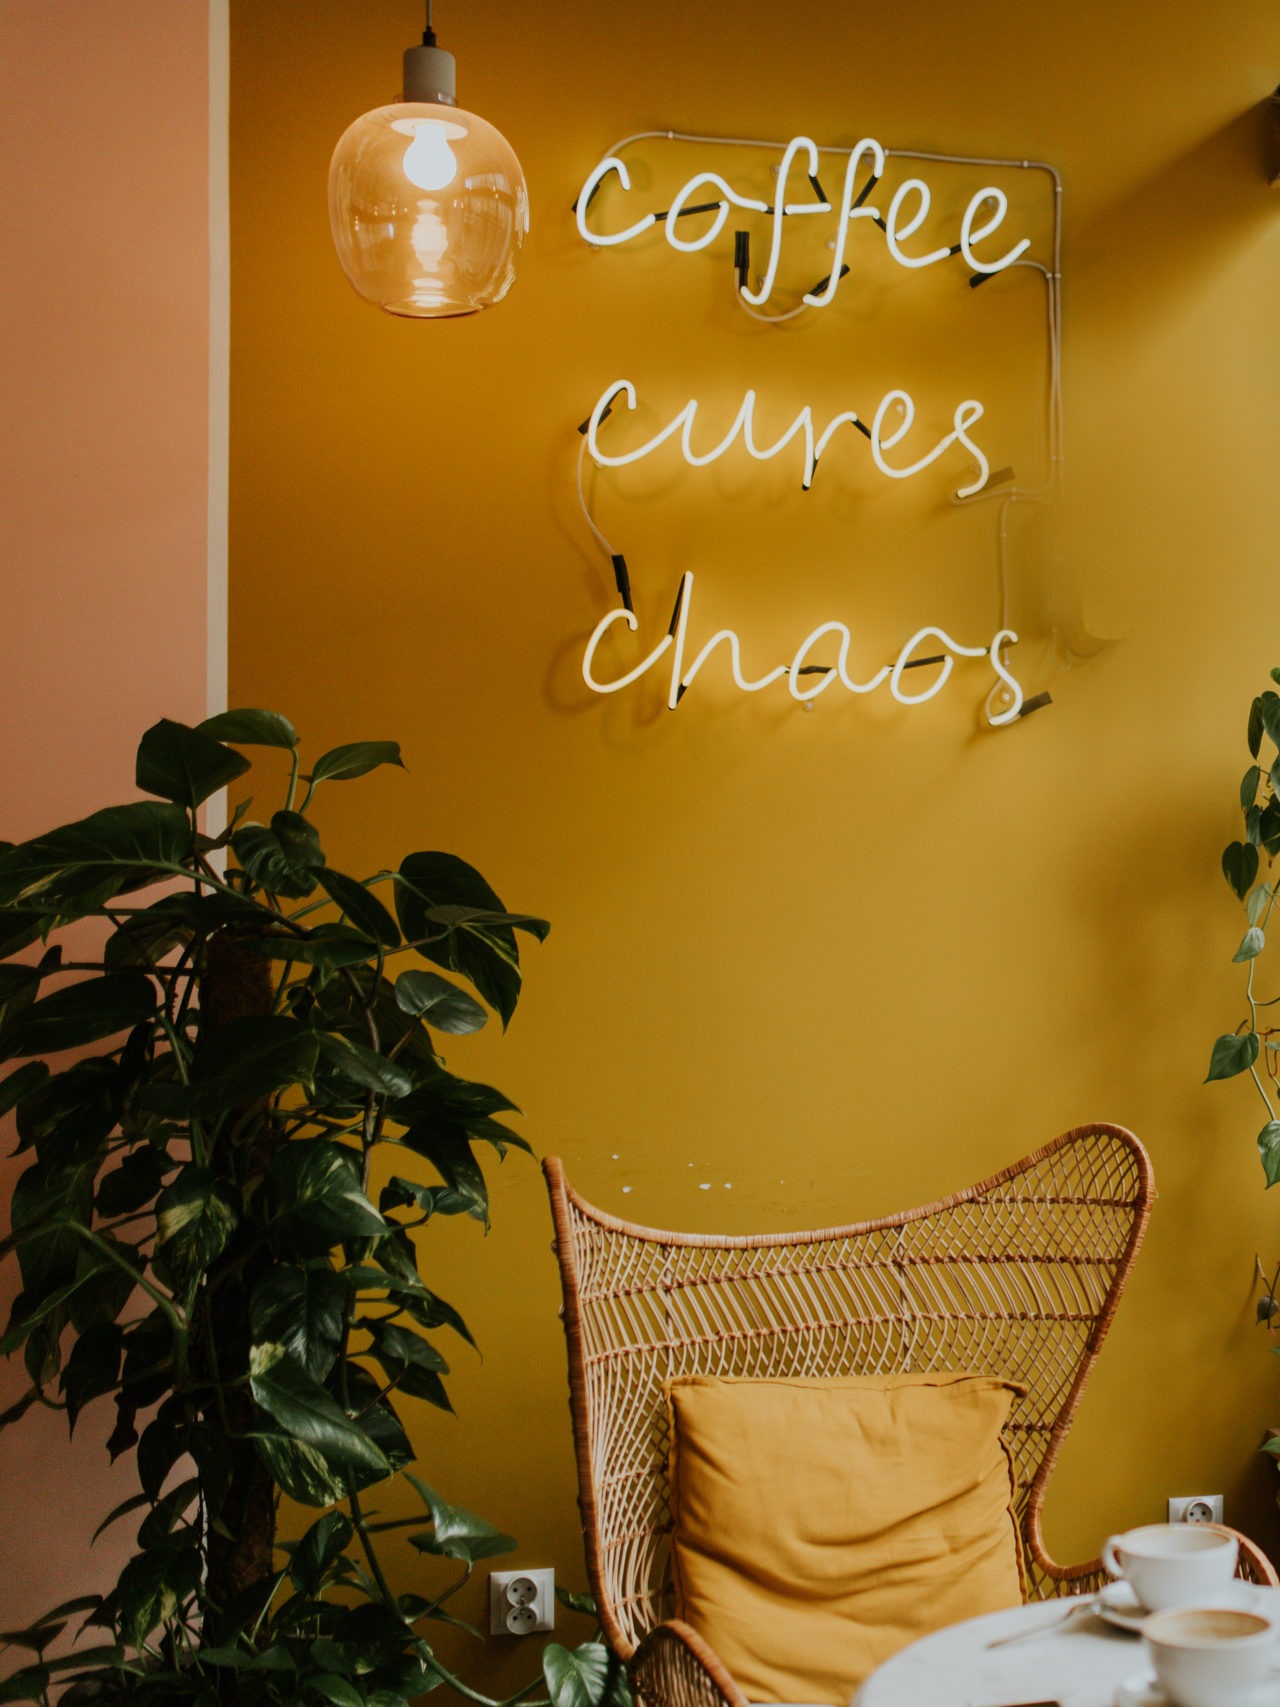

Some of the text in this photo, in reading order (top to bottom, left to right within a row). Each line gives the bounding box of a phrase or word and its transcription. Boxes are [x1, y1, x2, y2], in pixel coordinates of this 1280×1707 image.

[575, 136, 1032, 306] coffee
[586, 378, 991, 499] cures
[580, 570, 1024, 727] chaos
